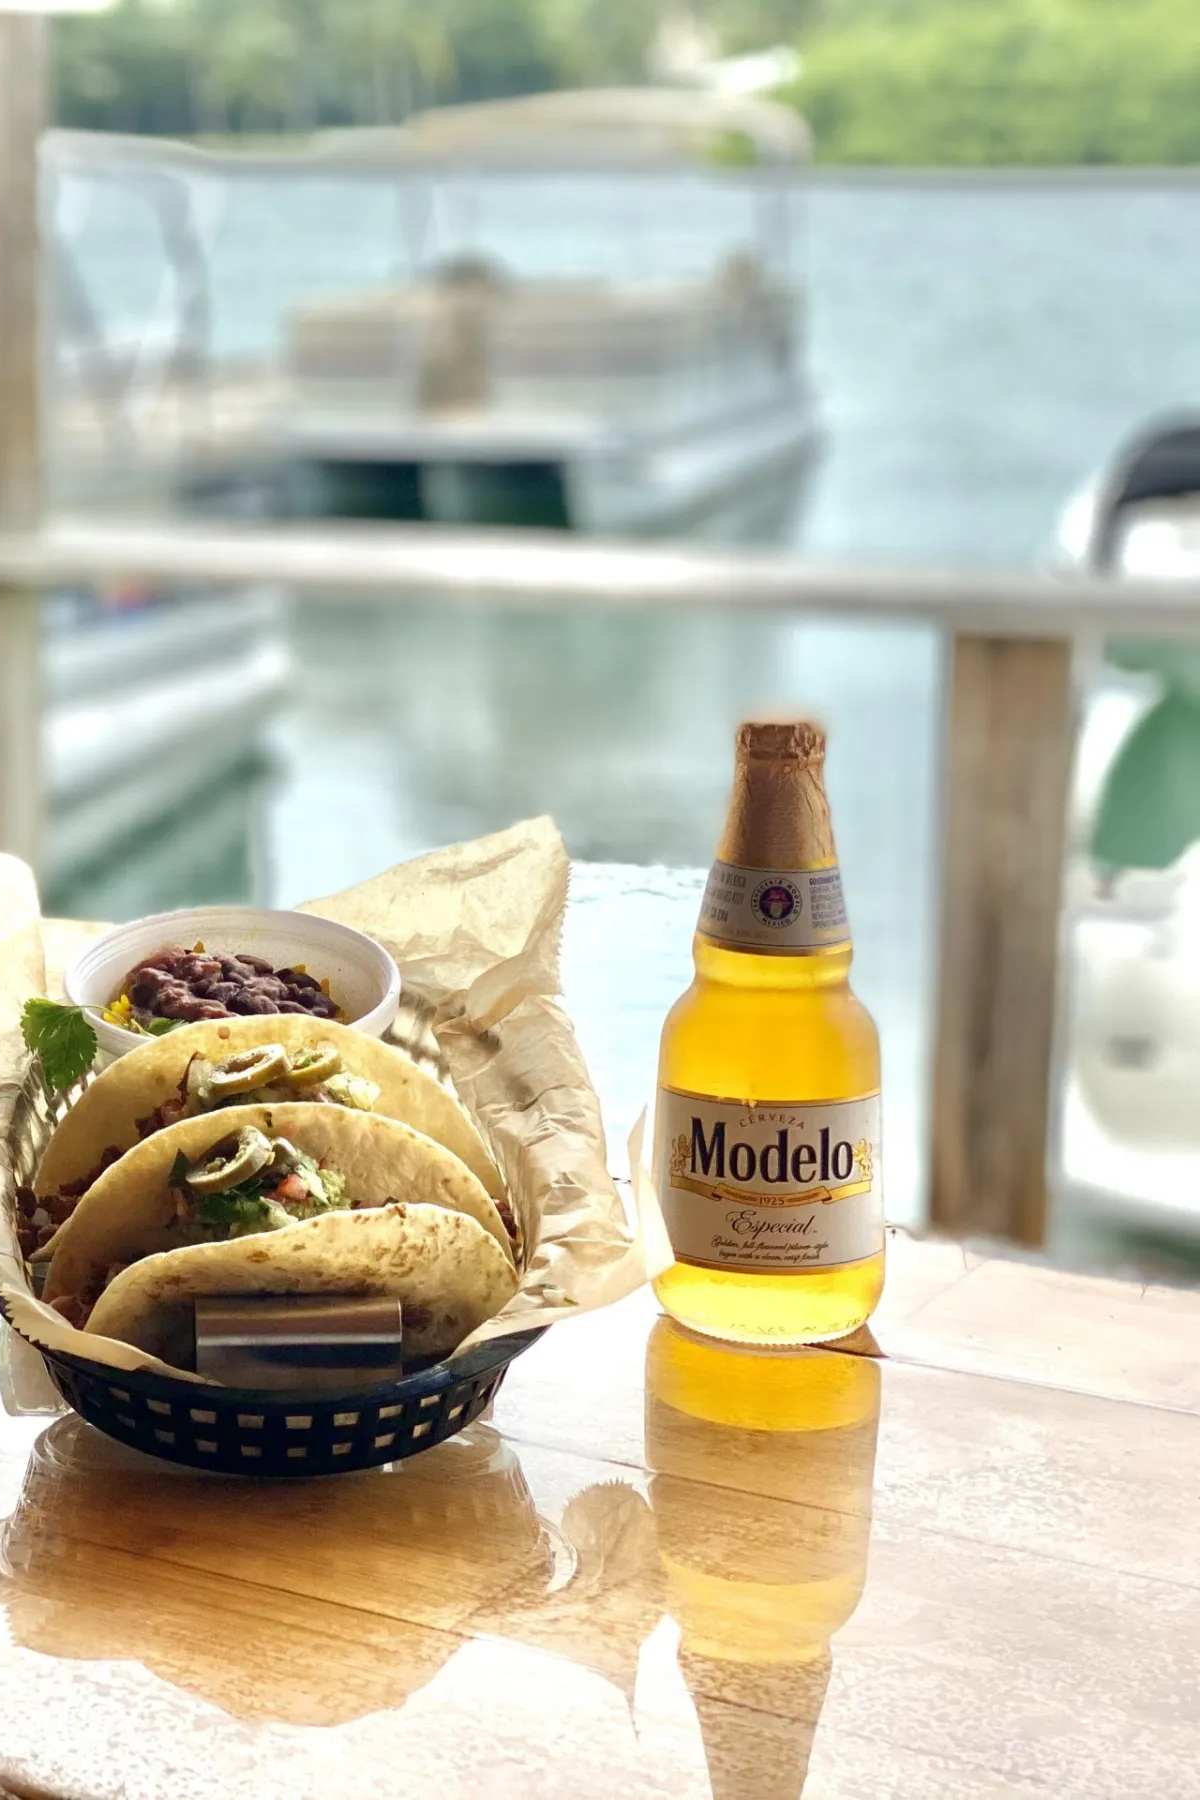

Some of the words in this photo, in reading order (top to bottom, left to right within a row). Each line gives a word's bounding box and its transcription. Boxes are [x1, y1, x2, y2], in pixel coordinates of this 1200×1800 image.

[739, 1113, 805, 1130] CERVEZA
[690, 1117, 853, 1183] Modelo
[759, 1196, 785, 1206] 1925
[725, 1209, 816, 1240] Especial
